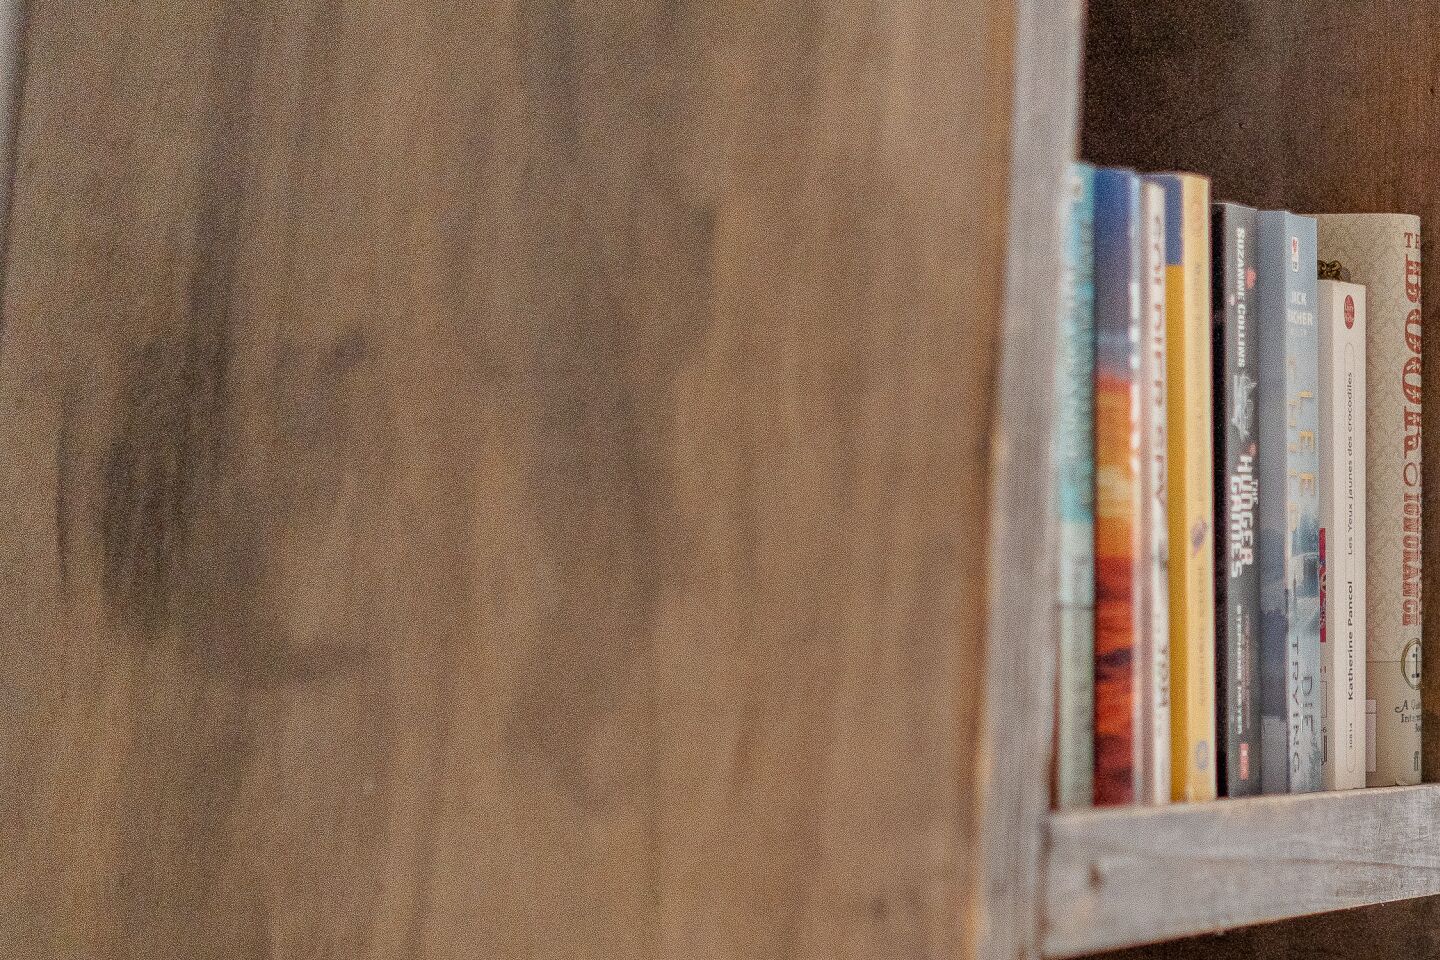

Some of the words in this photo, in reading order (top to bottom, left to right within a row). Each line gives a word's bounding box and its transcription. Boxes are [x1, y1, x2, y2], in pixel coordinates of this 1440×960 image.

[1236, 227, 1246, 300] SUZANNE
[1236, 304, 1247, 368] COLLINS
[1346, 371, 1354, 433] crocodiles
[1237, 455, 1254, 566] HUNGER
[1346, 459, 1354, 500] jaunes
[1230, 475, 1243, 578] GAMES
[1346, 581, 1354, 627] Pancol
[1346, 631, 1354, 701] Katherine
[1291, 636, 1301, 774] TRYING
[1301, 675, 1315, 733] DIE
